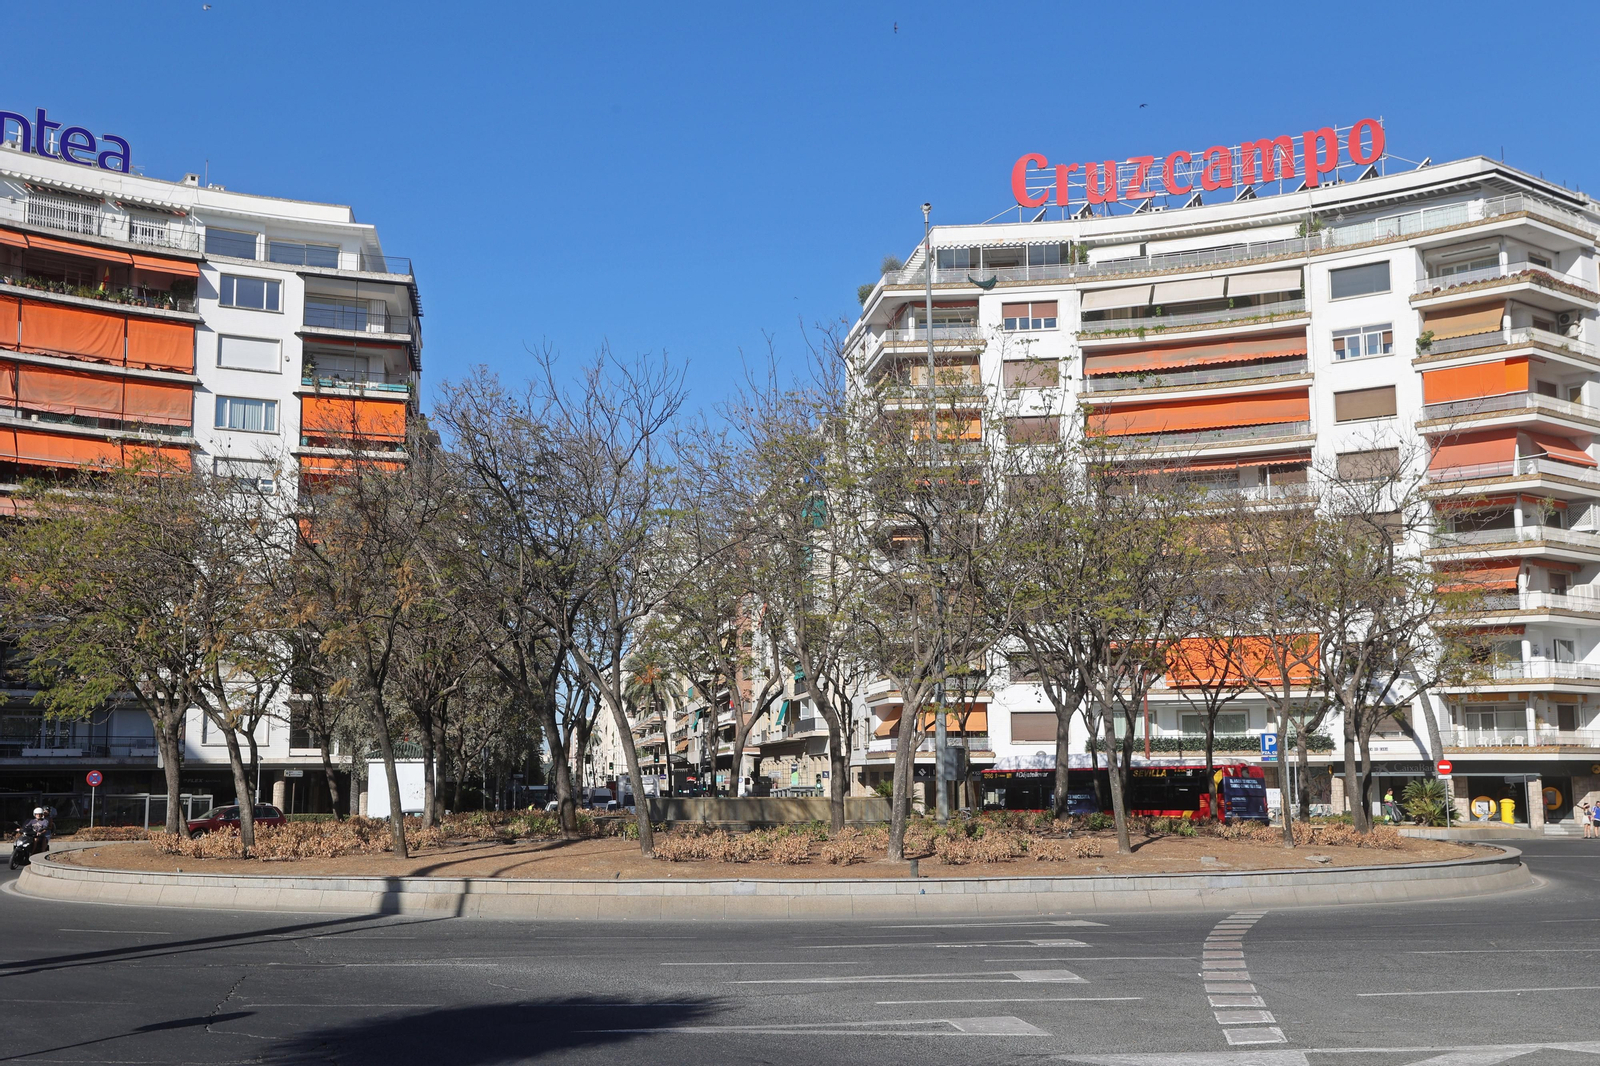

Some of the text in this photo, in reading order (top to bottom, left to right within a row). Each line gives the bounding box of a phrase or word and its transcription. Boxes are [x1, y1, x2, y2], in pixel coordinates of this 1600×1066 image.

[0, 106, 132, 174] ntea
[1011, 117, 1386, 209] Cruzcampo
[1086, 143, 1295, 196] CERVEZA
[1264, 735, 1277, 750] P
[1132, 769, 1167, 777] SEVILLA
[1393, 762, 1434, 773] CaixaBan
